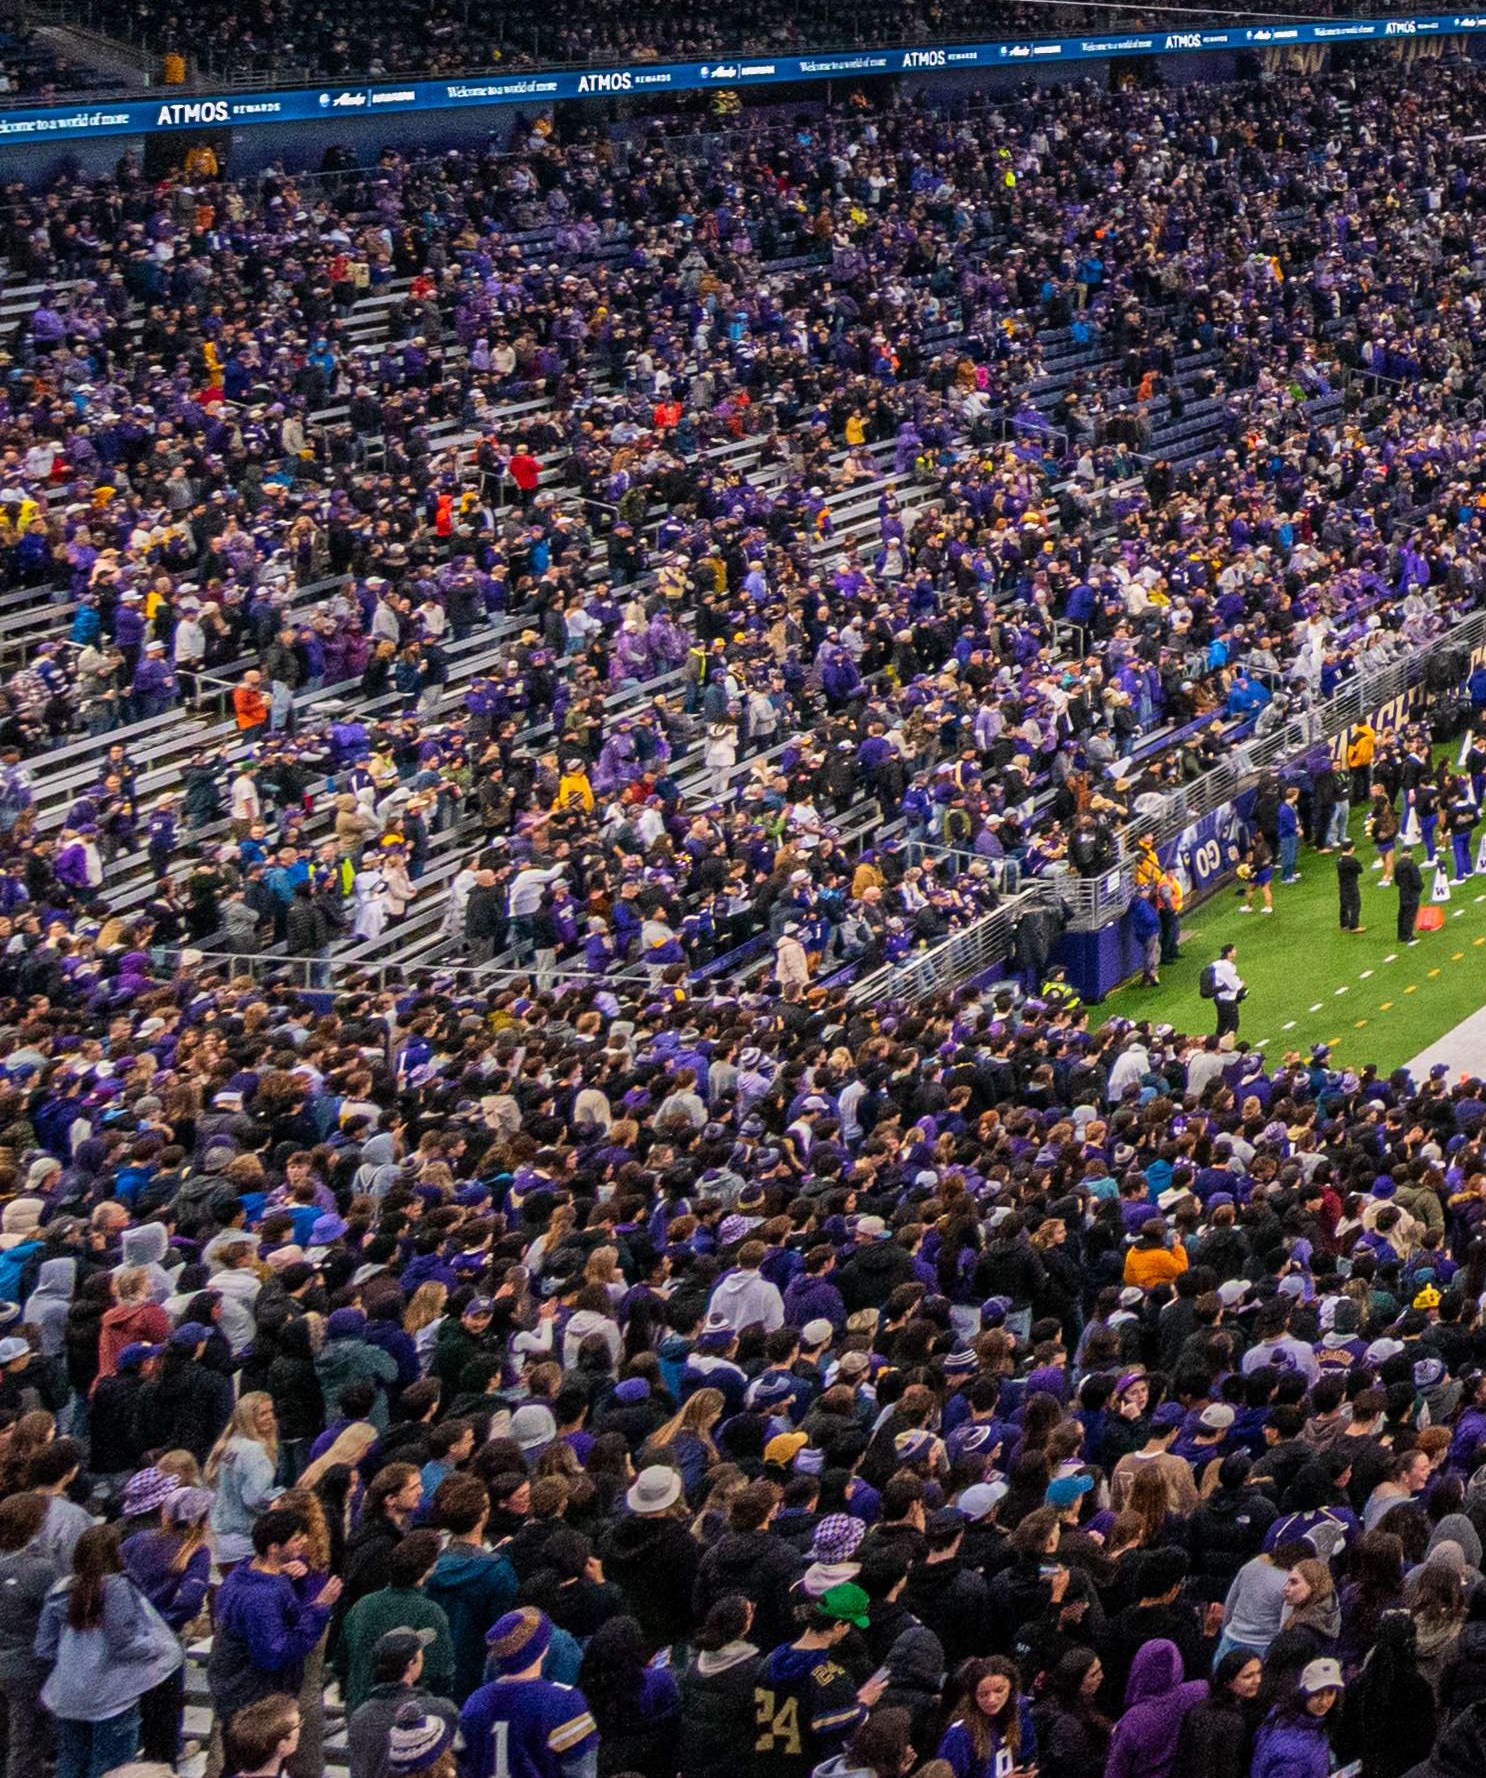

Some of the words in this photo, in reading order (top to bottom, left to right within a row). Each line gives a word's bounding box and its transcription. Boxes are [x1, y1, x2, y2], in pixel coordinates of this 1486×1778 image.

[1166, 33, 1202, 49] ATMOS
[903, 50, 946, 68] ATMOS
[578, 72, 634, 92] ATMOS
[157, 101, 230, 126] ATMOS
[233, 103, 282, 115] REWARDS
[1196, 839, 1221, 878] GO
[490, 1721, 511, 1778] 1
